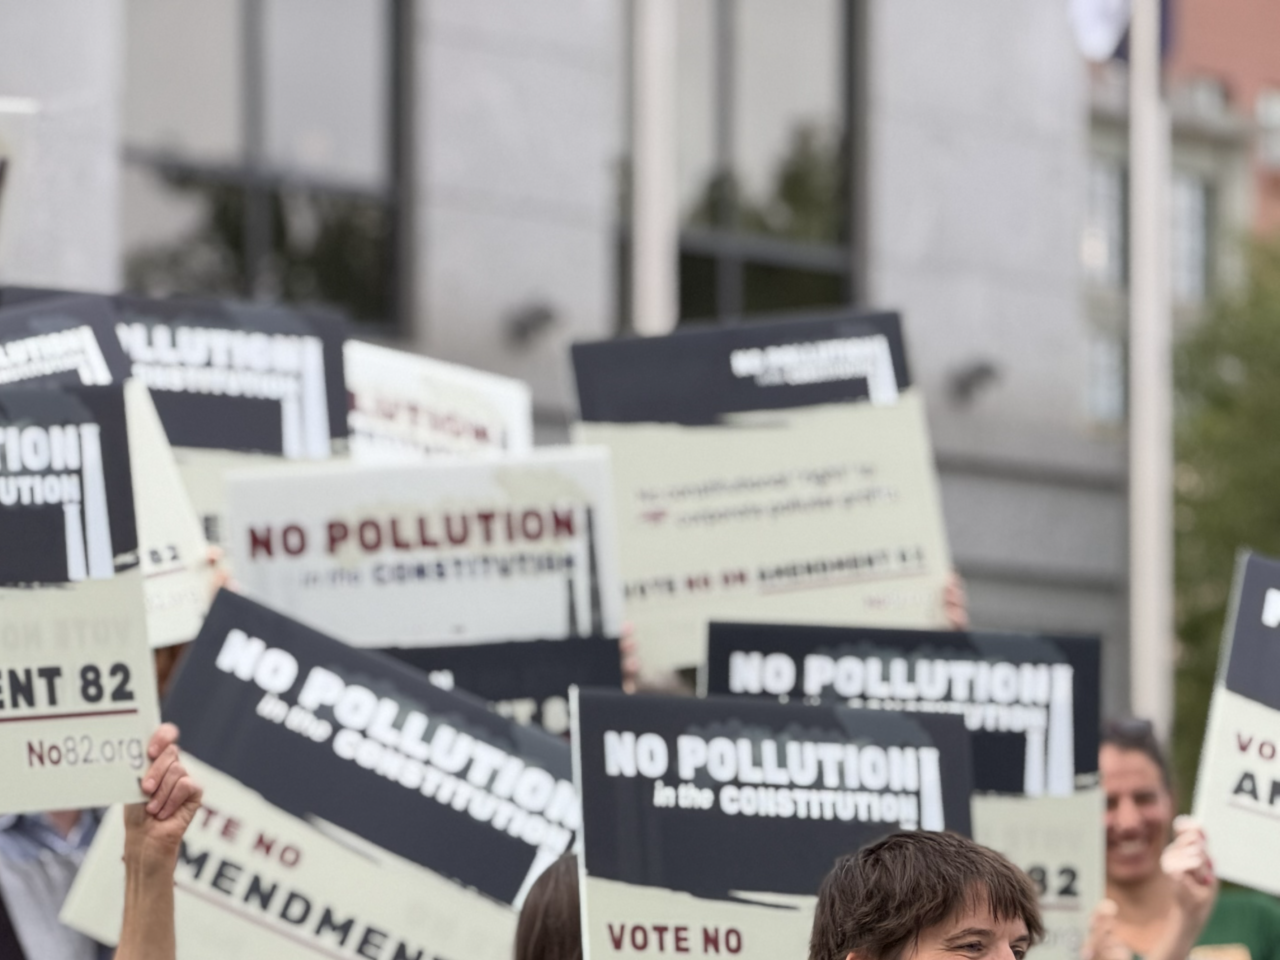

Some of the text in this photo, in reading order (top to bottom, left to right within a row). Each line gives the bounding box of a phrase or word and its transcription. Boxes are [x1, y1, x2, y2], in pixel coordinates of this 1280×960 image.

[248, 524, 306, 559] NO
[326, 508, 577, 555] POLLUTION
[371, 553, 577, 587] CONSTITUTION
[80, 663, 135, 703] 82
[728, 651, 1049, 703] NO POLLUTION
[27, 735, 144, 768] No82.org
[215, 628, 579, 832] NO POLLUTION
[256, 693, 571, 852] in the CONSTITUTION
[604, 731, 919, 792] NO POLLUTION
[653, 780, 918, 824] in the CONSTITUTION
[253, 832, 302, 869] NO
[608, 923, 743, 954] VOTE NO
